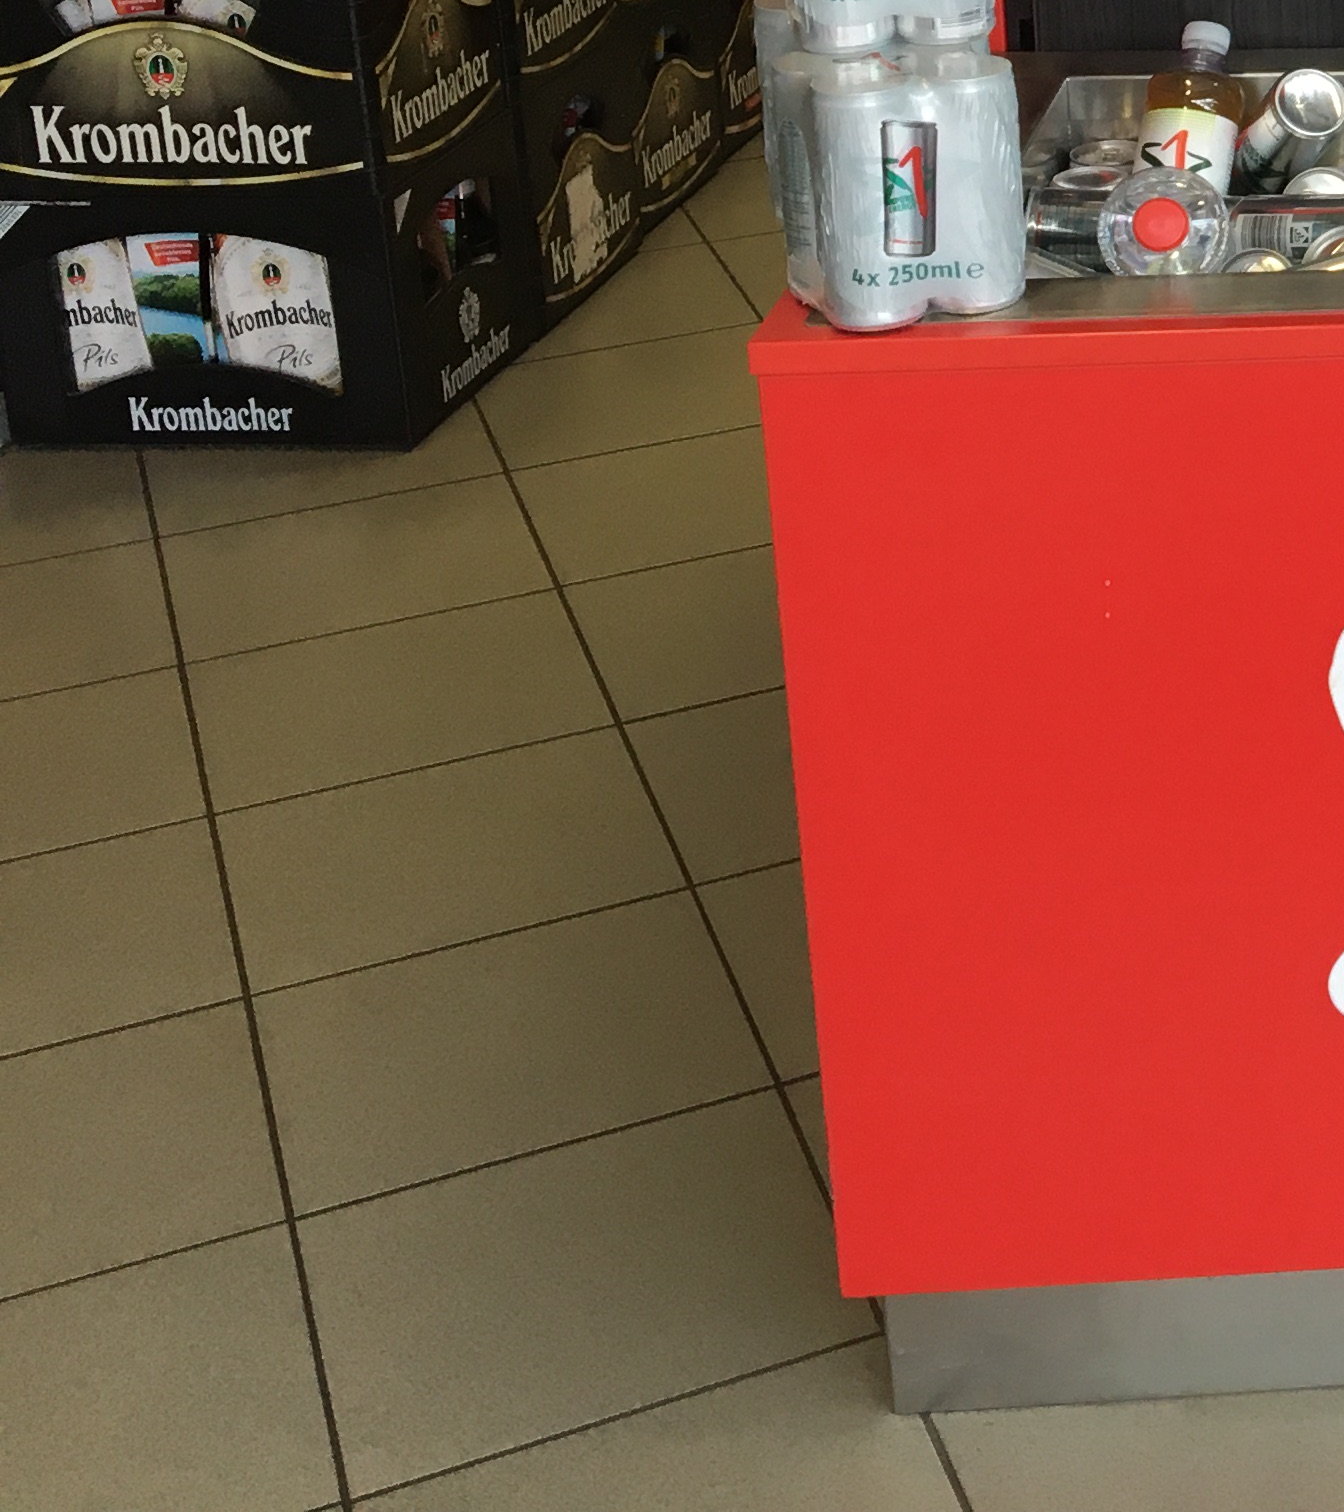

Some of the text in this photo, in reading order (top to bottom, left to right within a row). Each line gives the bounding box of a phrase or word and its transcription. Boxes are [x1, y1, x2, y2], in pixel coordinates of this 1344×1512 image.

[389, 48, 491, 144] Krombacher
[29, 105, 313, 165] Krombacher
[642, 107, 713, 190] Krombacher
[225, 299, 333, 340] Krombacher
[73, 343, 119, 376] Pils
[267, 345, 313, 377] Pils
[440, 323, 511, 403] Krombacher
[127, 396, 294, 432] Krombacher
